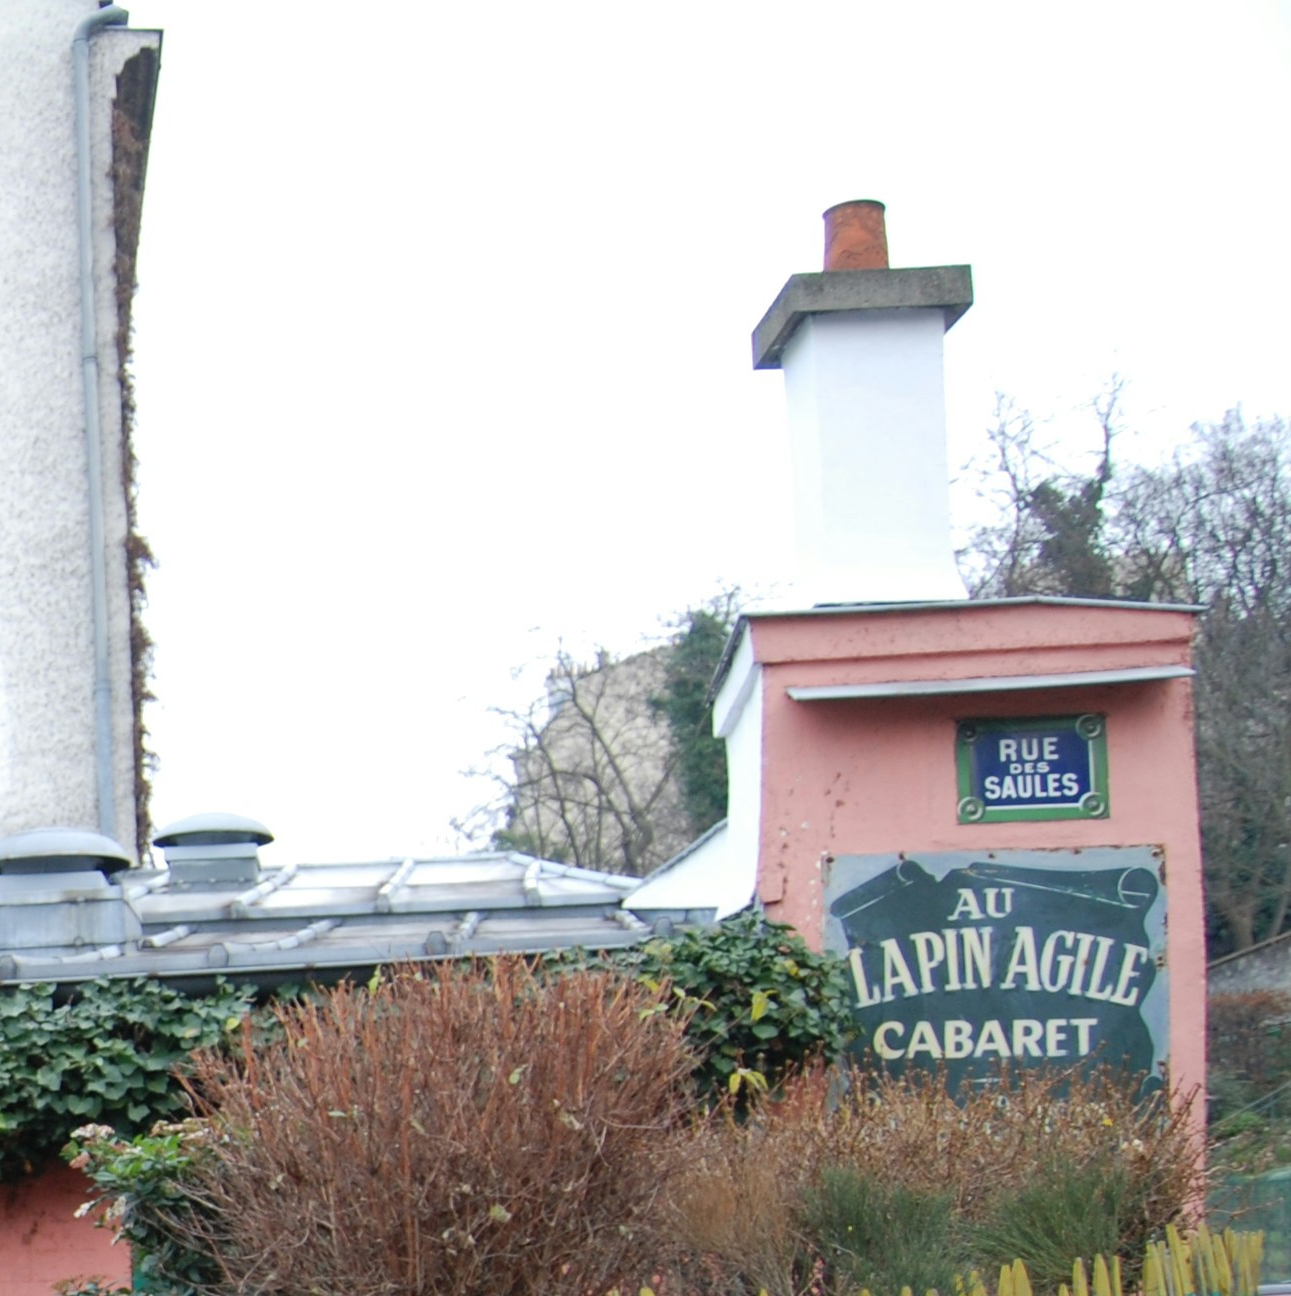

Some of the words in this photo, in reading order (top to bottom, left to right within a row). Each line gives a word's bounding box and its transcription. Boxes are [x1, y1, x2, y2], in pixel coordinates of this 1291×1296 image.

[999, 737, 1059, 762] RUE
[1009, 762, 1050, 774] DES
[984, 773, 1080, 800] SAULES
[947, 888, 1014, 921] AU
[849, 927, 993, 1009] LAPIN
[1000, 927, 1149, 1007] AGILE
[873, 1018, 1099, 1060] CABARET
